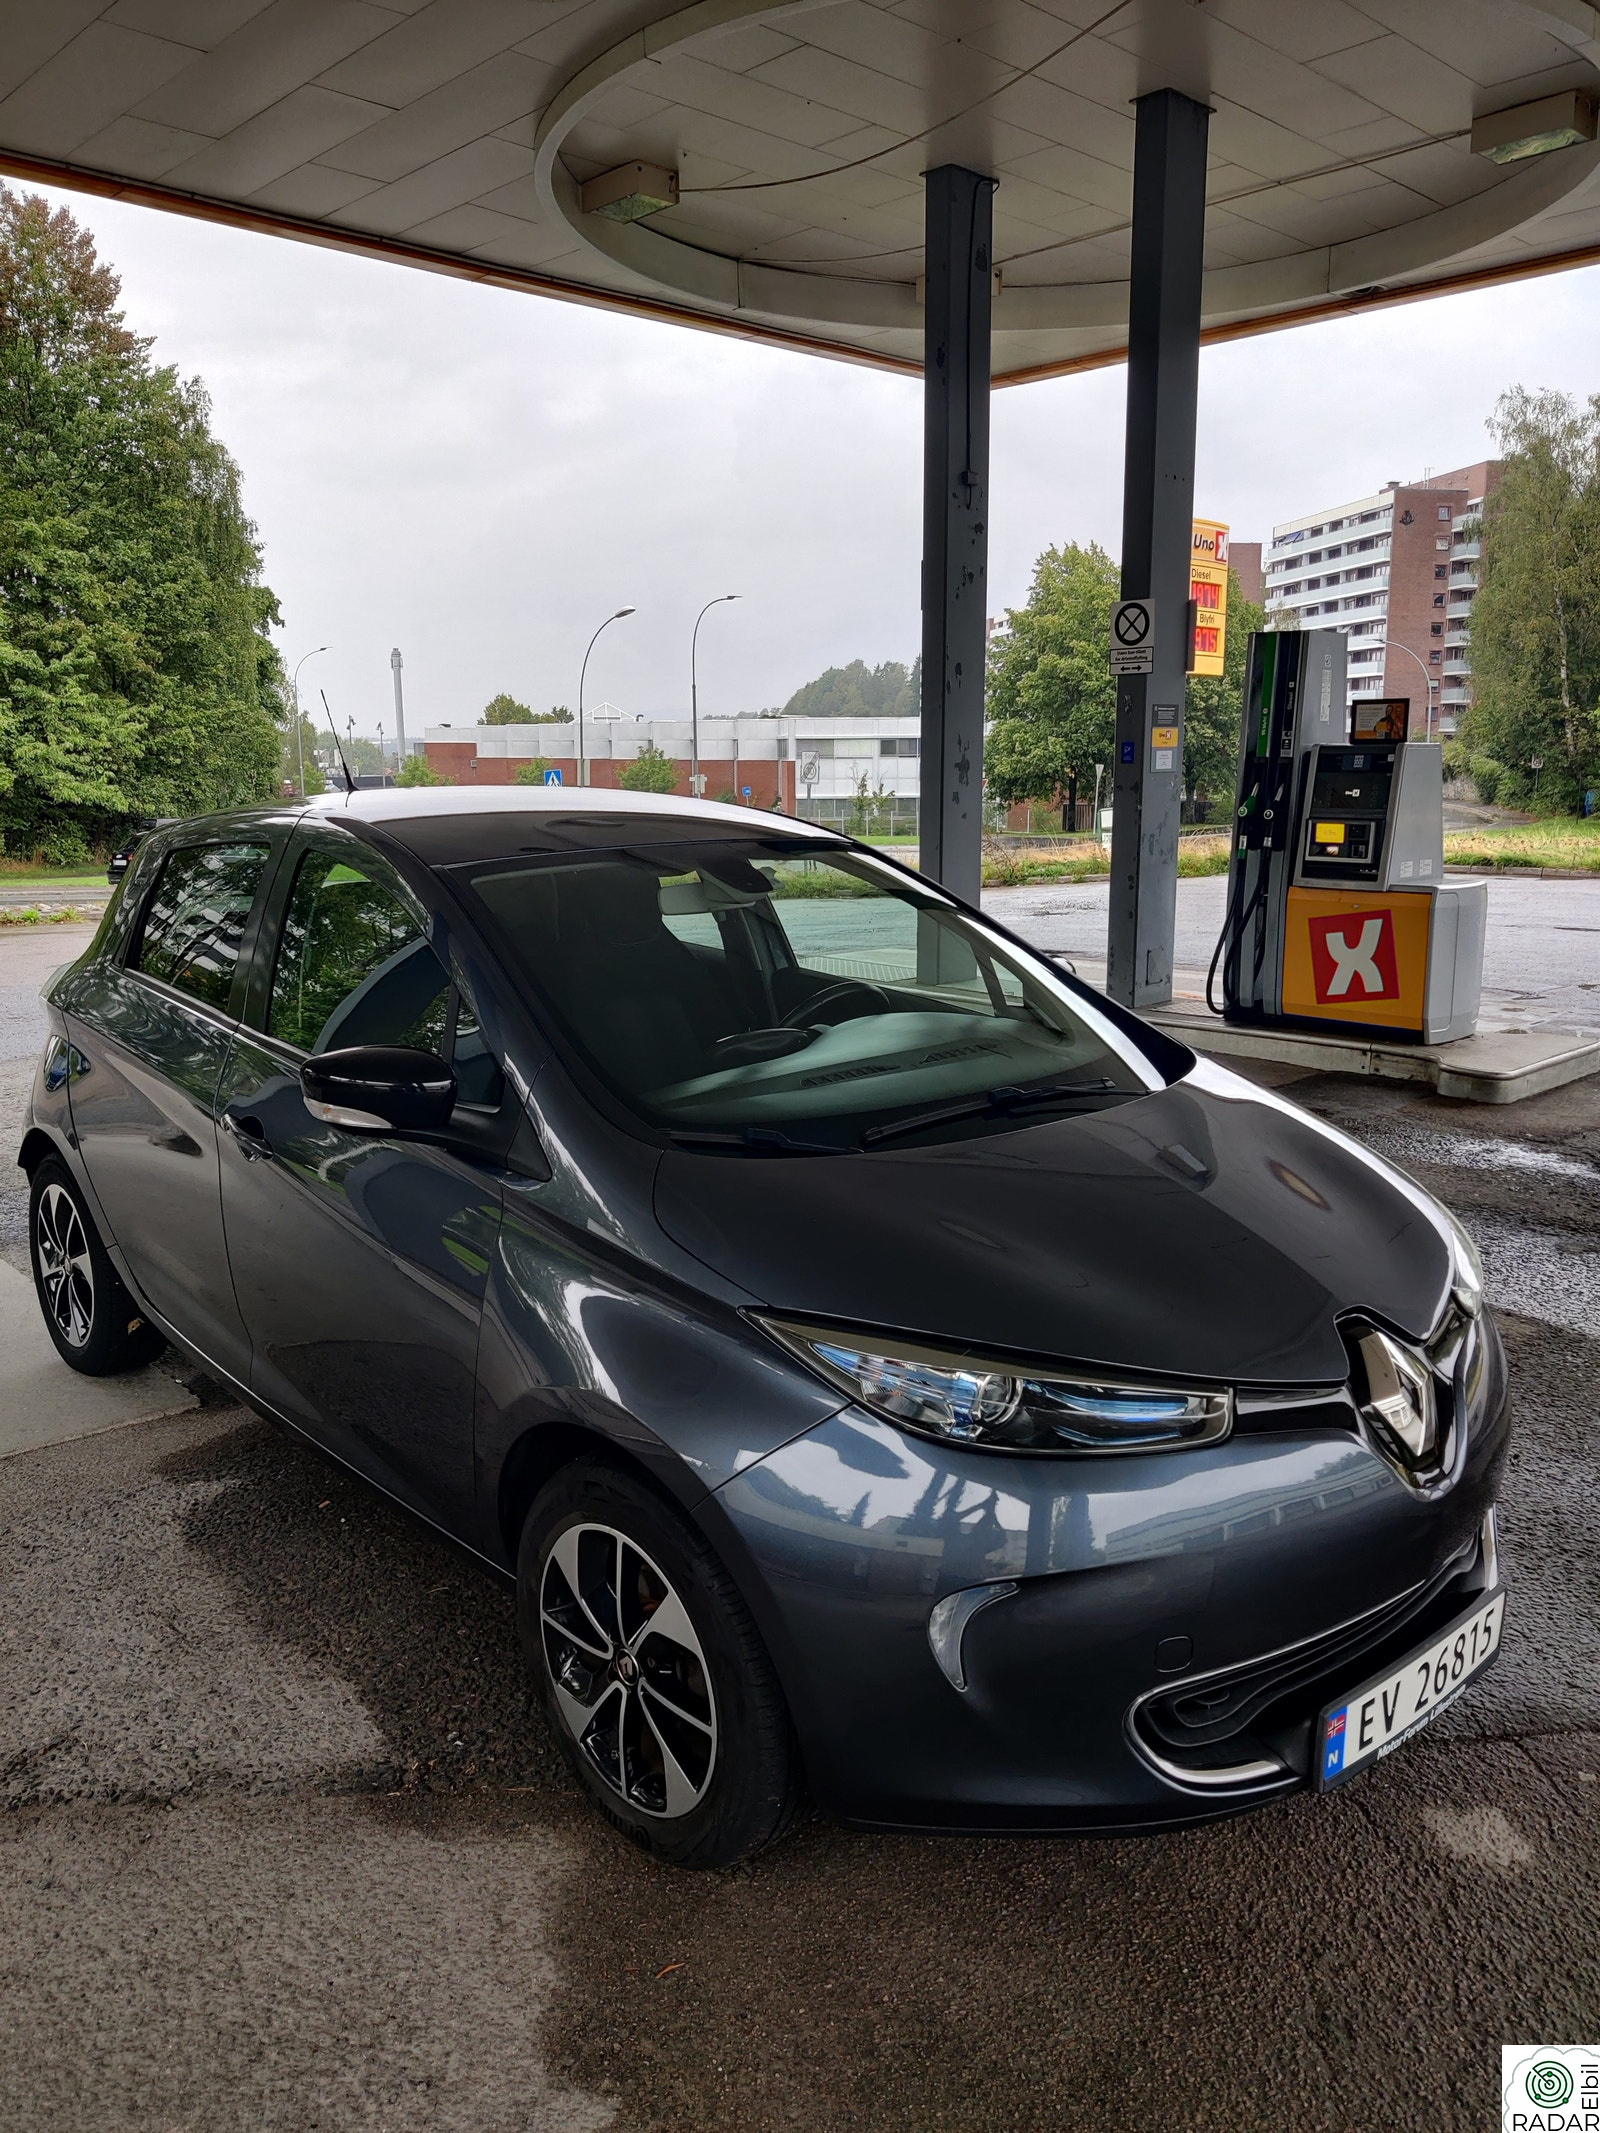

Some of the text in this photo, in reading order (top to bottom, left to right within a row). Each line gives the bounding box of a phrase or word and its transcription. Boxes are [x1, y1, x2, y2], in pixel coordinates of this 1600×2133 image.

[1193, 533, 1230, 561] Uno X
[1191, 568, 1212, 580] Diesel
[1199, 613, 1215, 626] Blyfri
[1195, 628, 1217, 652] 9.75
[1325, 918, 1384, 996] X
[1328, 1607, 1494, 1768] N EV 26815
